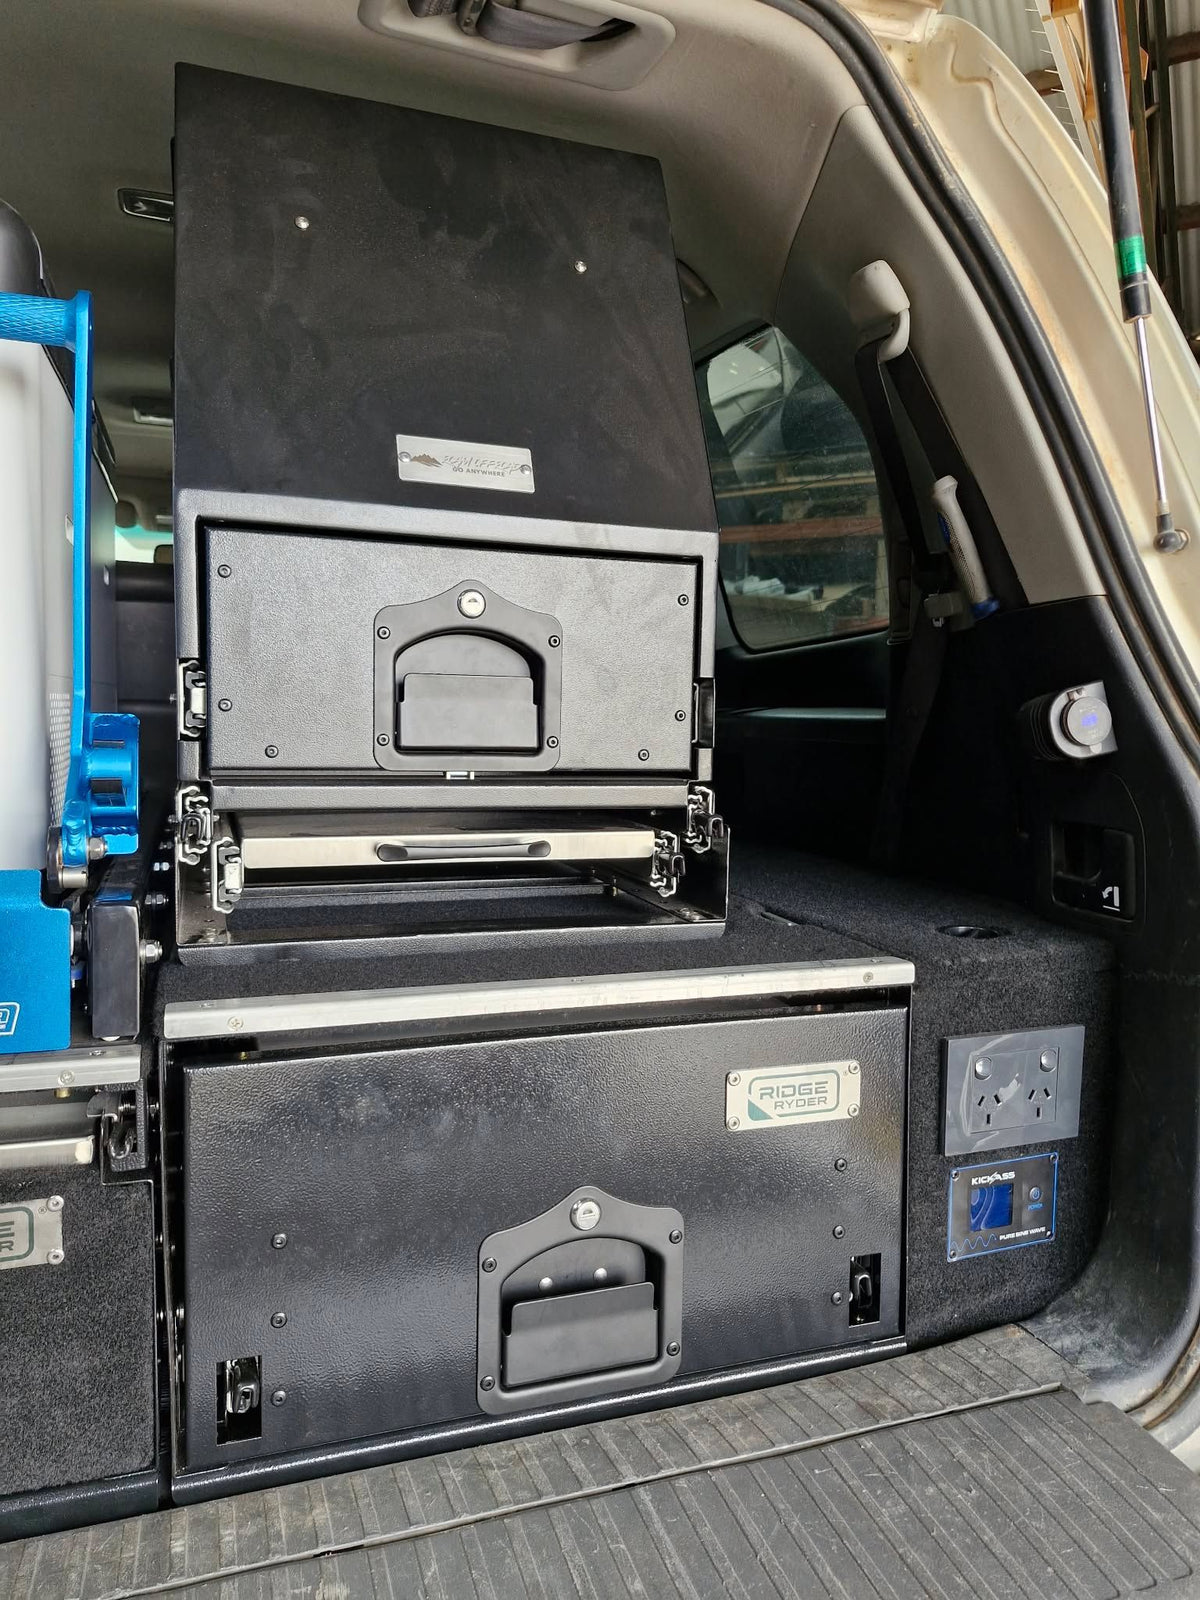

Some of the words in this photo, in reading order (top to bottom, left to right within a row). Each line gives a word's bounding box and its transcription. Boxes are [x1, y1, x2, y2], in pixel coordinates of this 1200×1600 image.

[466, 468, 505, 477] ANYWHERE
[759, 1081, 828, 1100] RIDGE
[774, 1096, 827, 1110] RYDER
[999, 1232, 1016, 1241] PURE
[1015, 1229, 1029, 1238] SINE
[1029, 1226, 1046, 1235] WAVE
